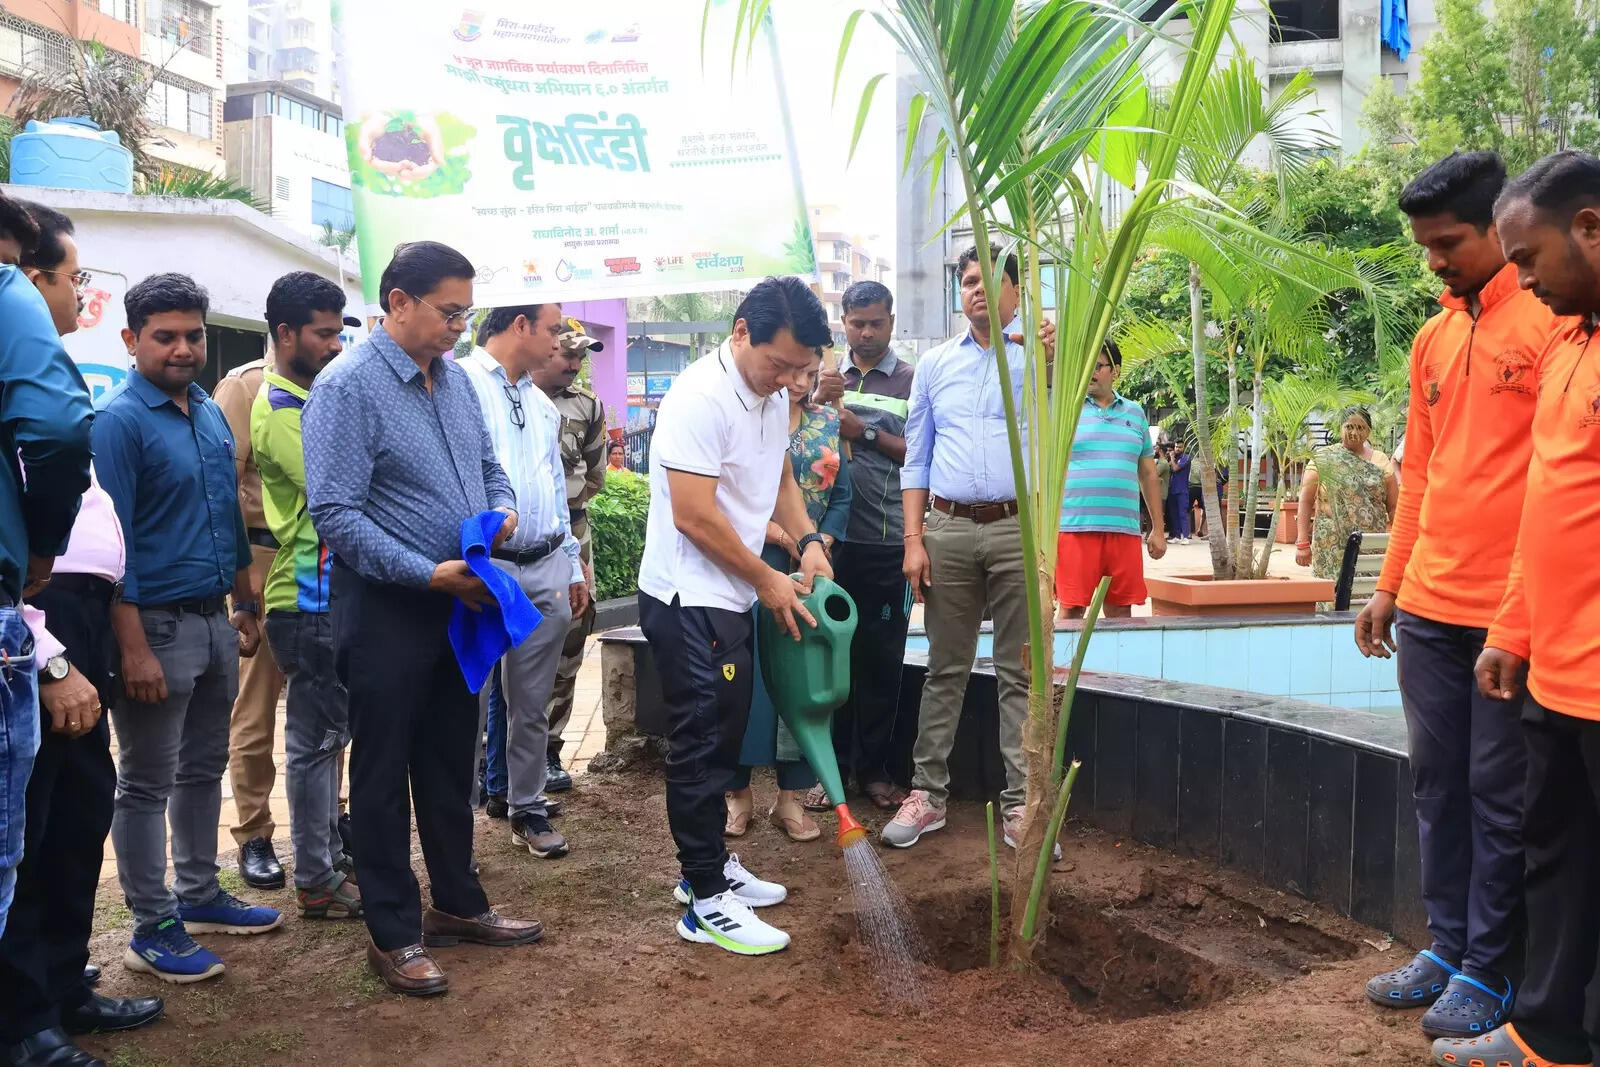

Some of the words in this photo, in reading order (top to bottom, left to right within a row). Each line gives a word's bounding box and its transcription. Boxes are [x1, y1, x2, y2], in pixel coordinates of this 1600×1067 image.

[462, 56, 483, 72] जून
[484, 58, 534, 73] जागतिक
[535, 61, 586, 75] पर्यावरण
[480, 75, 530, 95] वसुंधरा
[533, 78, 591, 96] अभियान
[622, 76, 669, 95] अंतर्गत
[496, 110, 651, 191] वृक्षदिंडी
[532, 225, 582, 240] राधाविनोद
[599, 222, 619, 236] शर्मा
[696, 252, 744, 269] सर्वेक्षण
